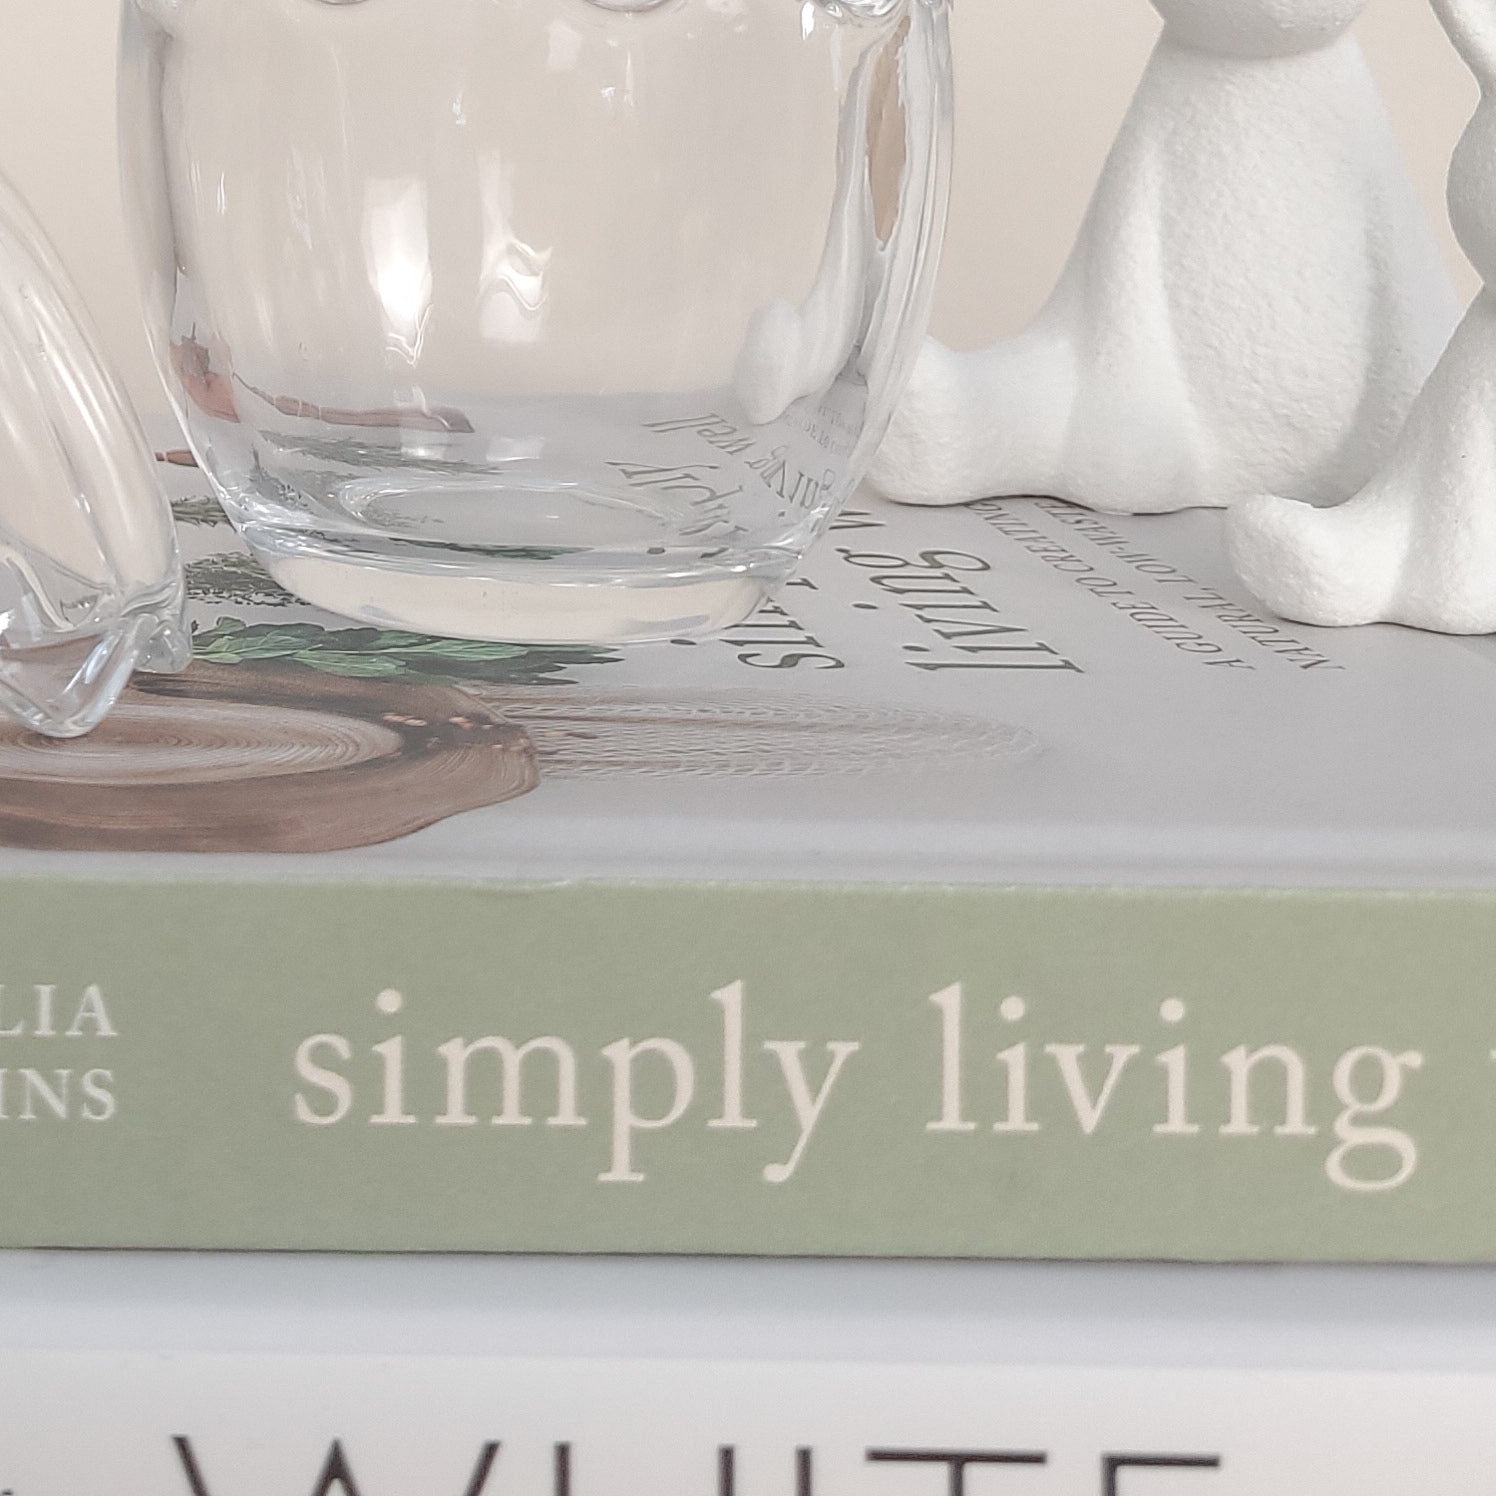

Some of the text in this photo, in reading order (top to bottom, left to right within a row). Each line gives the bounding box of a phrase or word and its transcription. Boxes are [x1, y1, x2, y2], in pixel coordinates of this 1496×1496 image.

[835, 548, 1085, 673] living
[963, 503, 1256, 671] A GUIDE TO CREATING
[1183, 587, 1346, 670] NATURAL,
[293, 979, 1423, 1193] simply living
